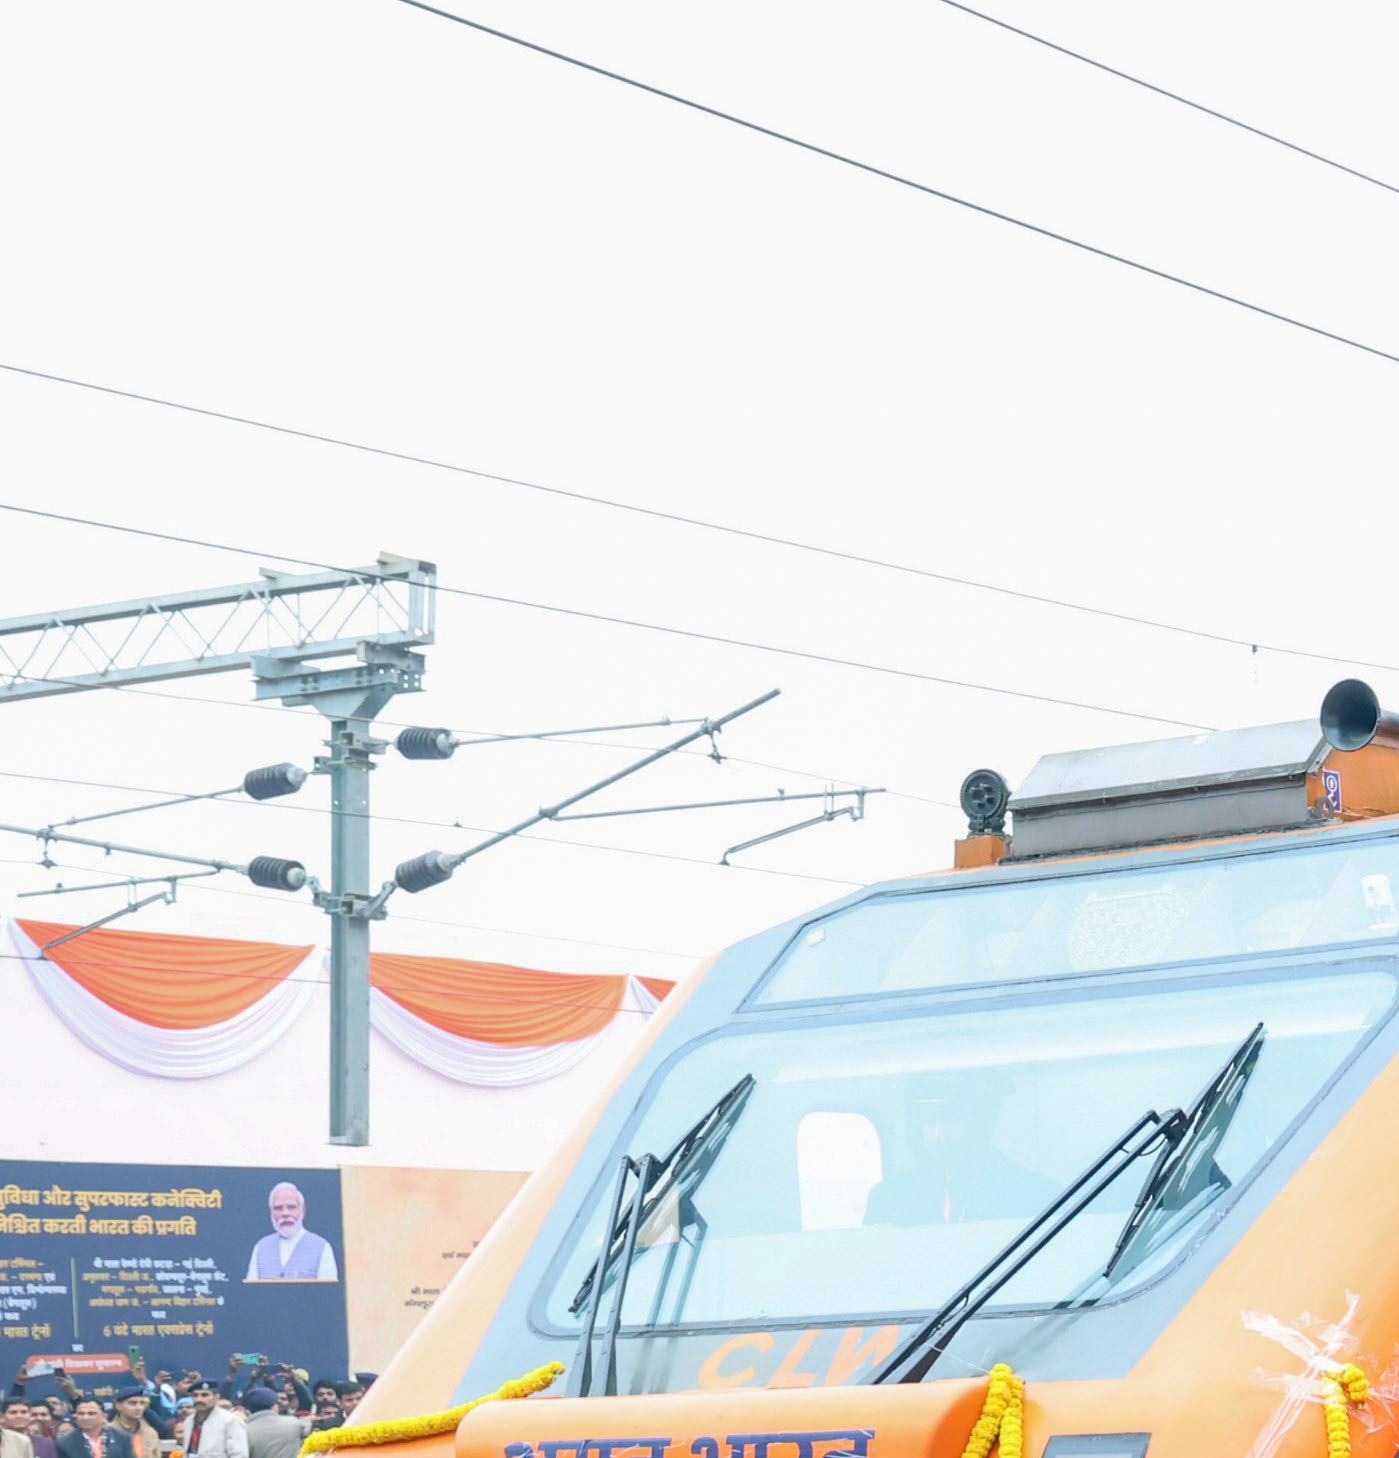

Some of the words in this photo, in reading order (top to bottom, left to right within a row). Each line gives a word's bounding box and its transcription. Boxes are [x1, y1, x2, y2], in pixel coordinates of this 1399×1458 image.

[42, 1184, 71, 1206] और
[73, 1190, 149, 1212] सुपरफास्ट
[43, 1214, 87, 1235] करती
[88, 1218, 130, 1235] भारत
[131, 1214, 153, 1235] की
[155, 1215, 197, 1236] प्रगति
